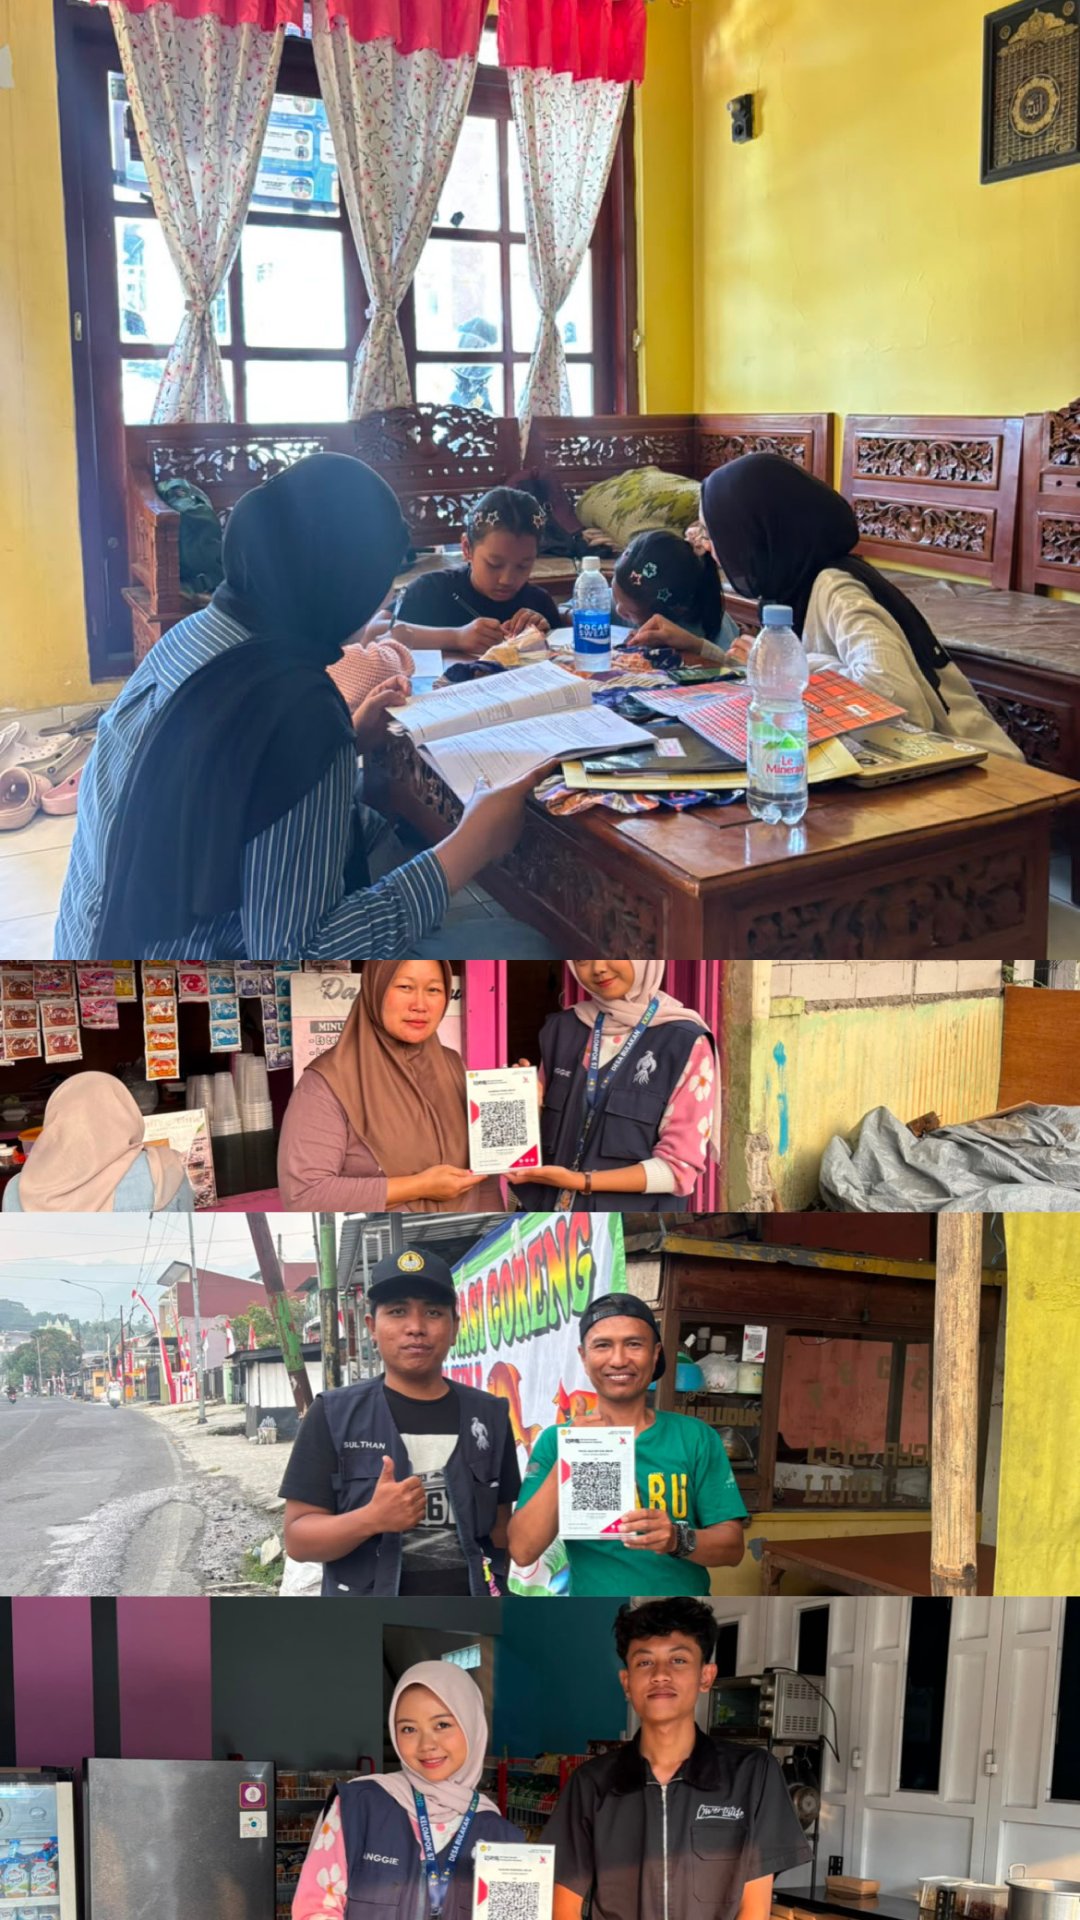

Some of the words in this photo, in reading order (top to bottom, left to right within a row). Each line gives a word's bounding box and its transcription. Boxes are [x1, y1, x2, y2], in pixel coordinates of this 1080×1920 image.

[781, 755, 793, 766] Le
[318, 1023, 345, 1033] MINU
[486, 1211, 596, 1352] GORENG
[343, 1440, 386, 1450] SULTHAN
[883, 1442, 930, 1467] Aya
[420, 1815, 433, 1852] KELOMPOK
[448, 1843, 460, 1861] DESA
[456, 1816, 470, 1844] BULAKAN
